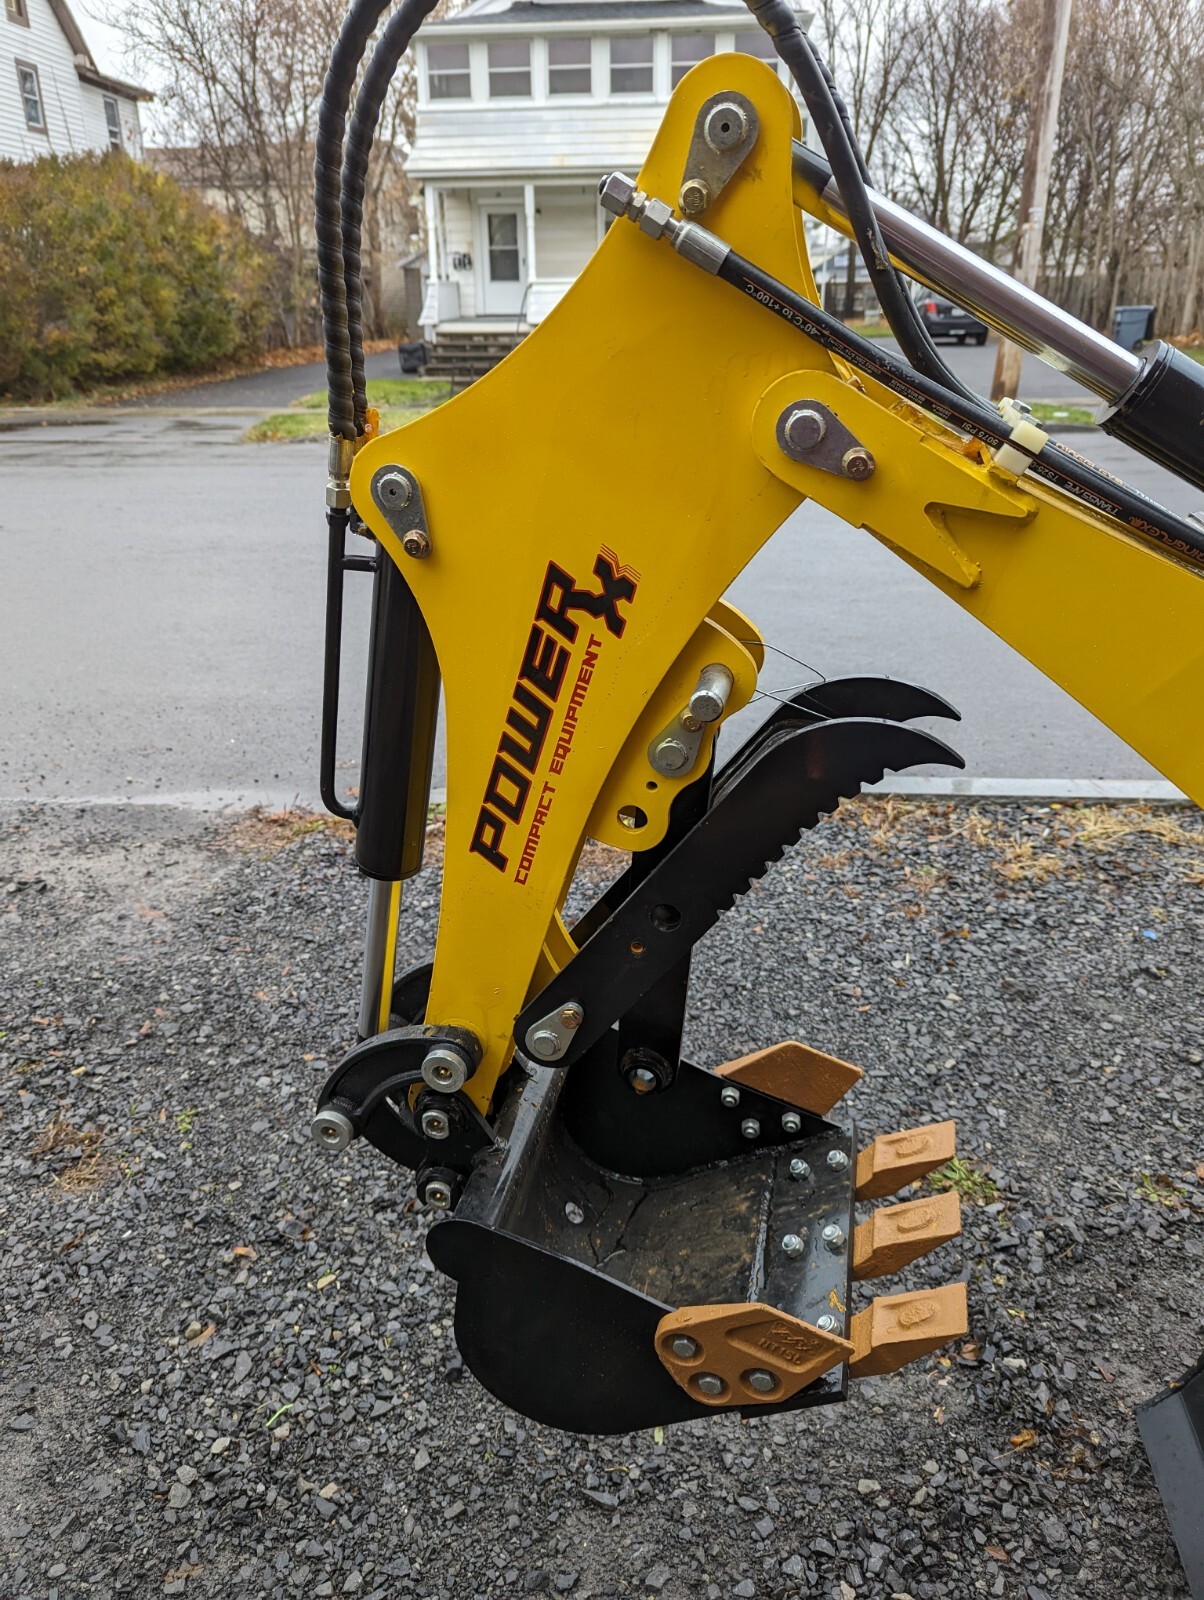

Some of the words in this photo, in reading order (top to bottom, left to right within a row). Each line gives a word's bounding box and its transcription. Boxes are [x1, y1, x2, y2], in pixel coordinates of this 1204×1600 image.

[743, 282, 782, 311] +100°C
[780, 307, 793, 319] to
[793, 315, 822, 337] -40°C
[961, 421, 978, 434] PSI
[977, 430, 999, 446] 5075
[514, 780, 556, 885] COMPACT
[549, 633, 603, 776] EQUIPMENT
